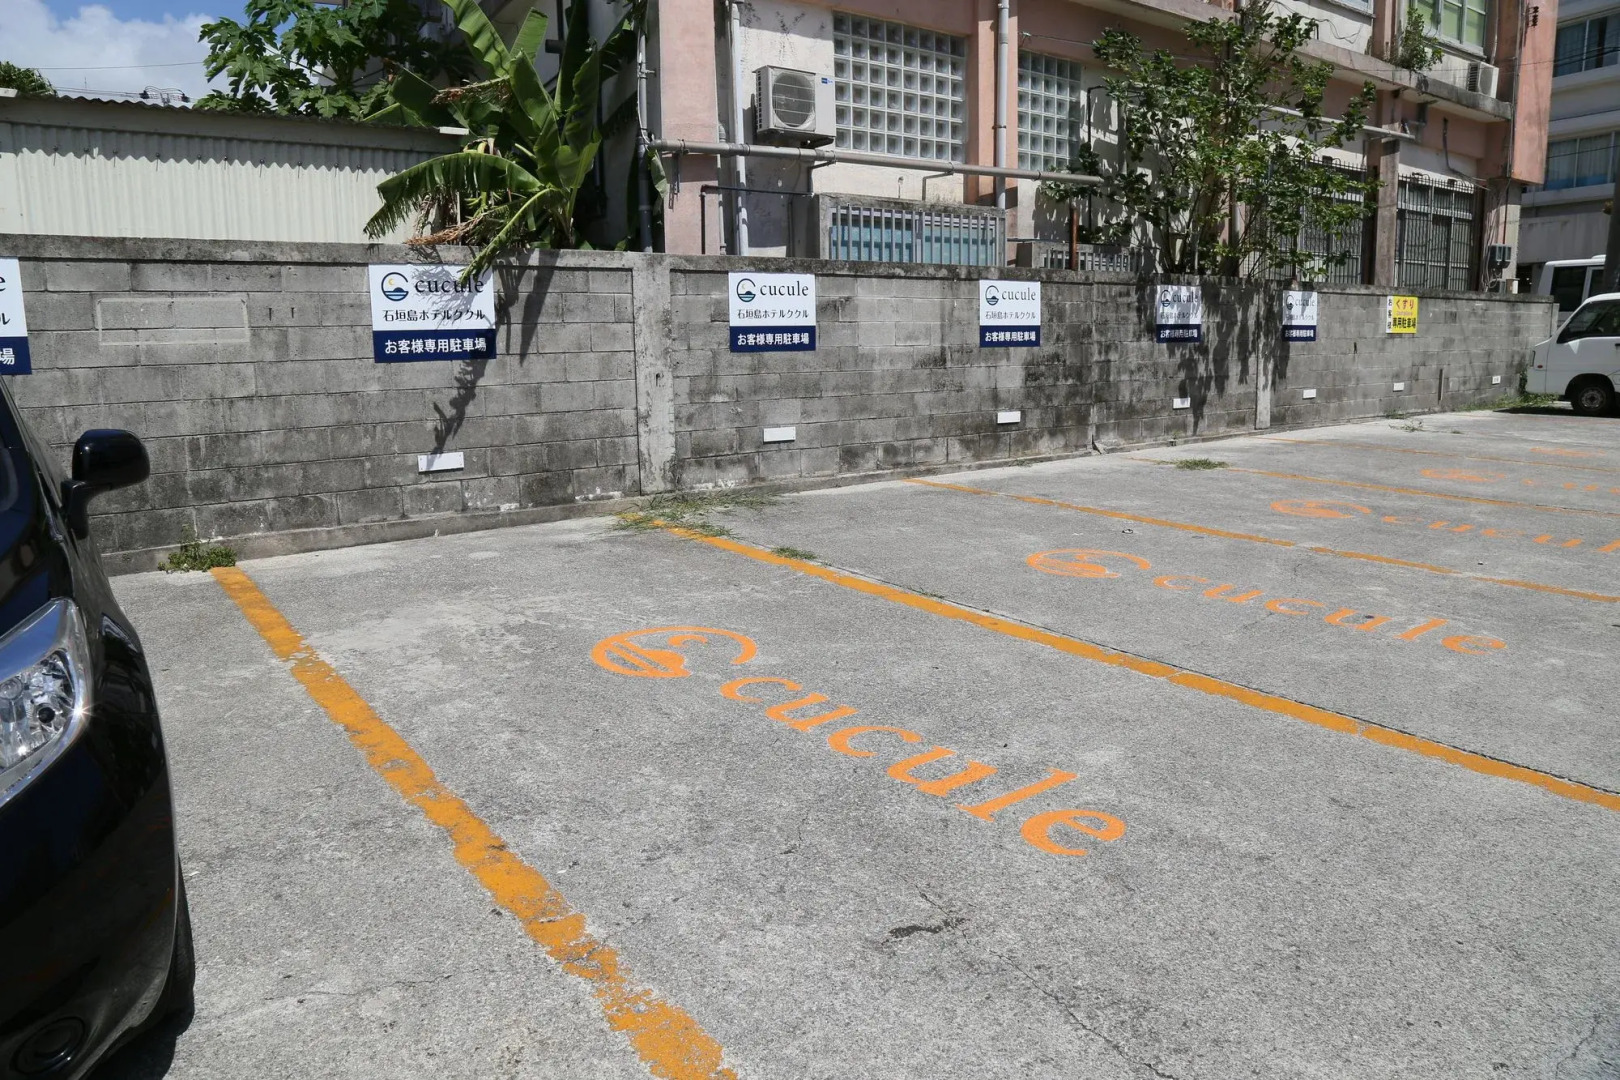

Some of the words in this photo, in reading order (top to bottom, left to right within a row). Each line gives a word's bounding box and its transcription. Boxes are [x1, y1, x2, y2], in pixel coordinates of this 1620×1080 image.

[760, 280, 809, 296] cucule
[1001, 287, 1036, 301] cucule
[383, 309, 486, 322] 石垣島ホテルククル
[737, 308, 809, 319] 石垣島ホテルククル
[385, 337, 487, 354] お客様専用駐車場
[737, 332, 810, 345] お客様専用駐車場
[1152, 575, 1508, 656] cucule
[719, 676, 1127, 857] cucule
